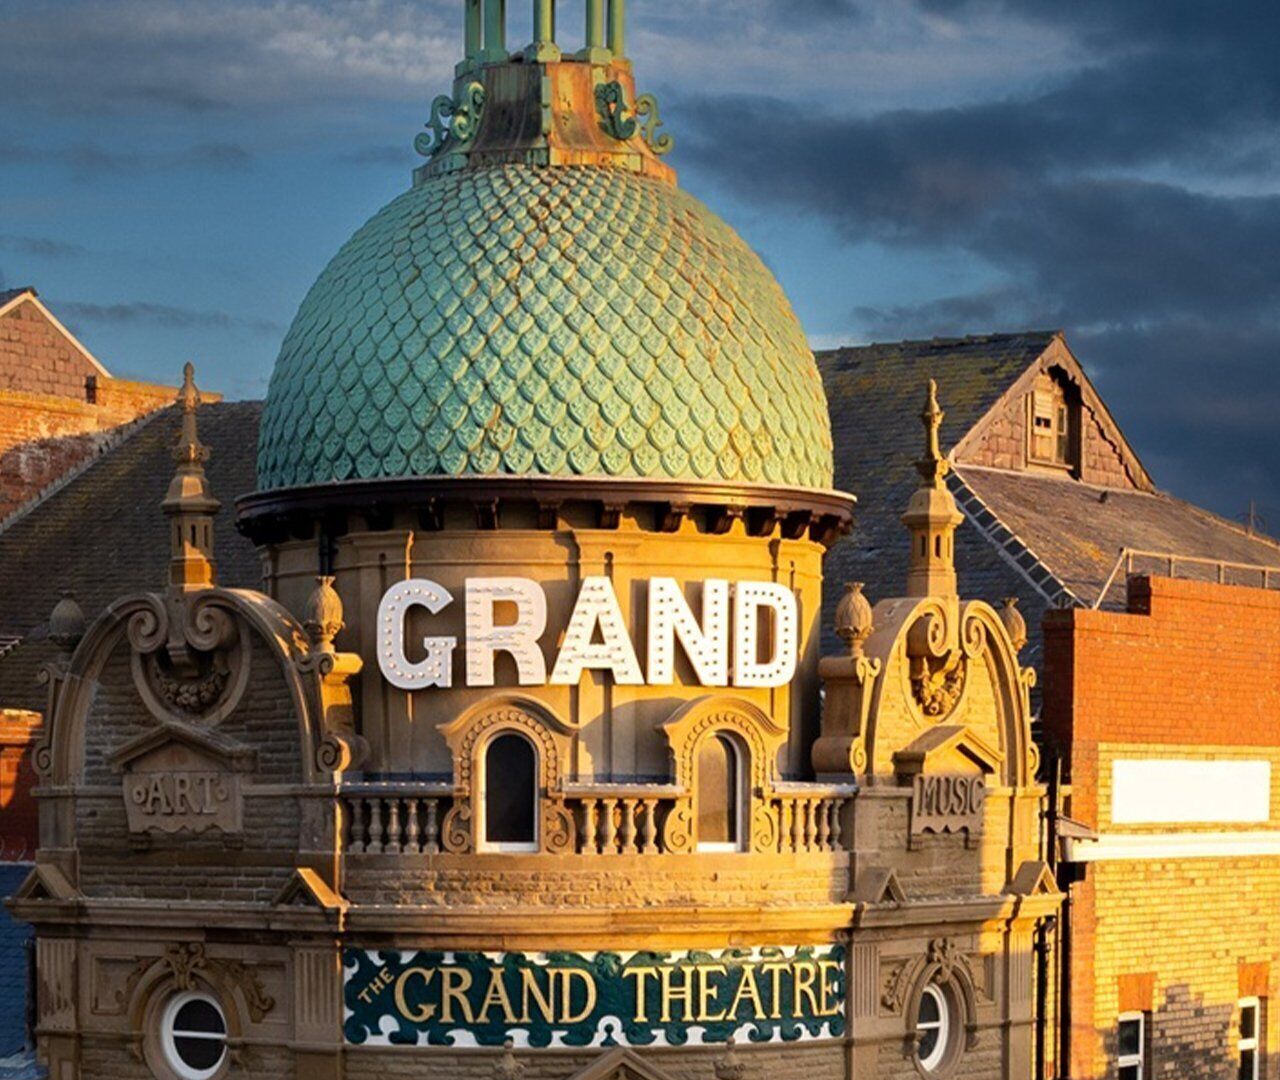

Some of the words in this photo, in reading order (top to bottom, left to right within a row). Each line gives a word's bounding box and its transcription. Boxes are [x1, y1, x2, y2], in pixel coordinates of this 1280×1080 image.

[377, 576, 797, 689] GRAND
[142, 772, 218, 815] ART
[914, 775, 984, 816] MUSIC
[357, 966, 395, 1004] THE
[394, 966, 597, 1024] GRAND
[622, 961, 841, 1023] THEATRE
